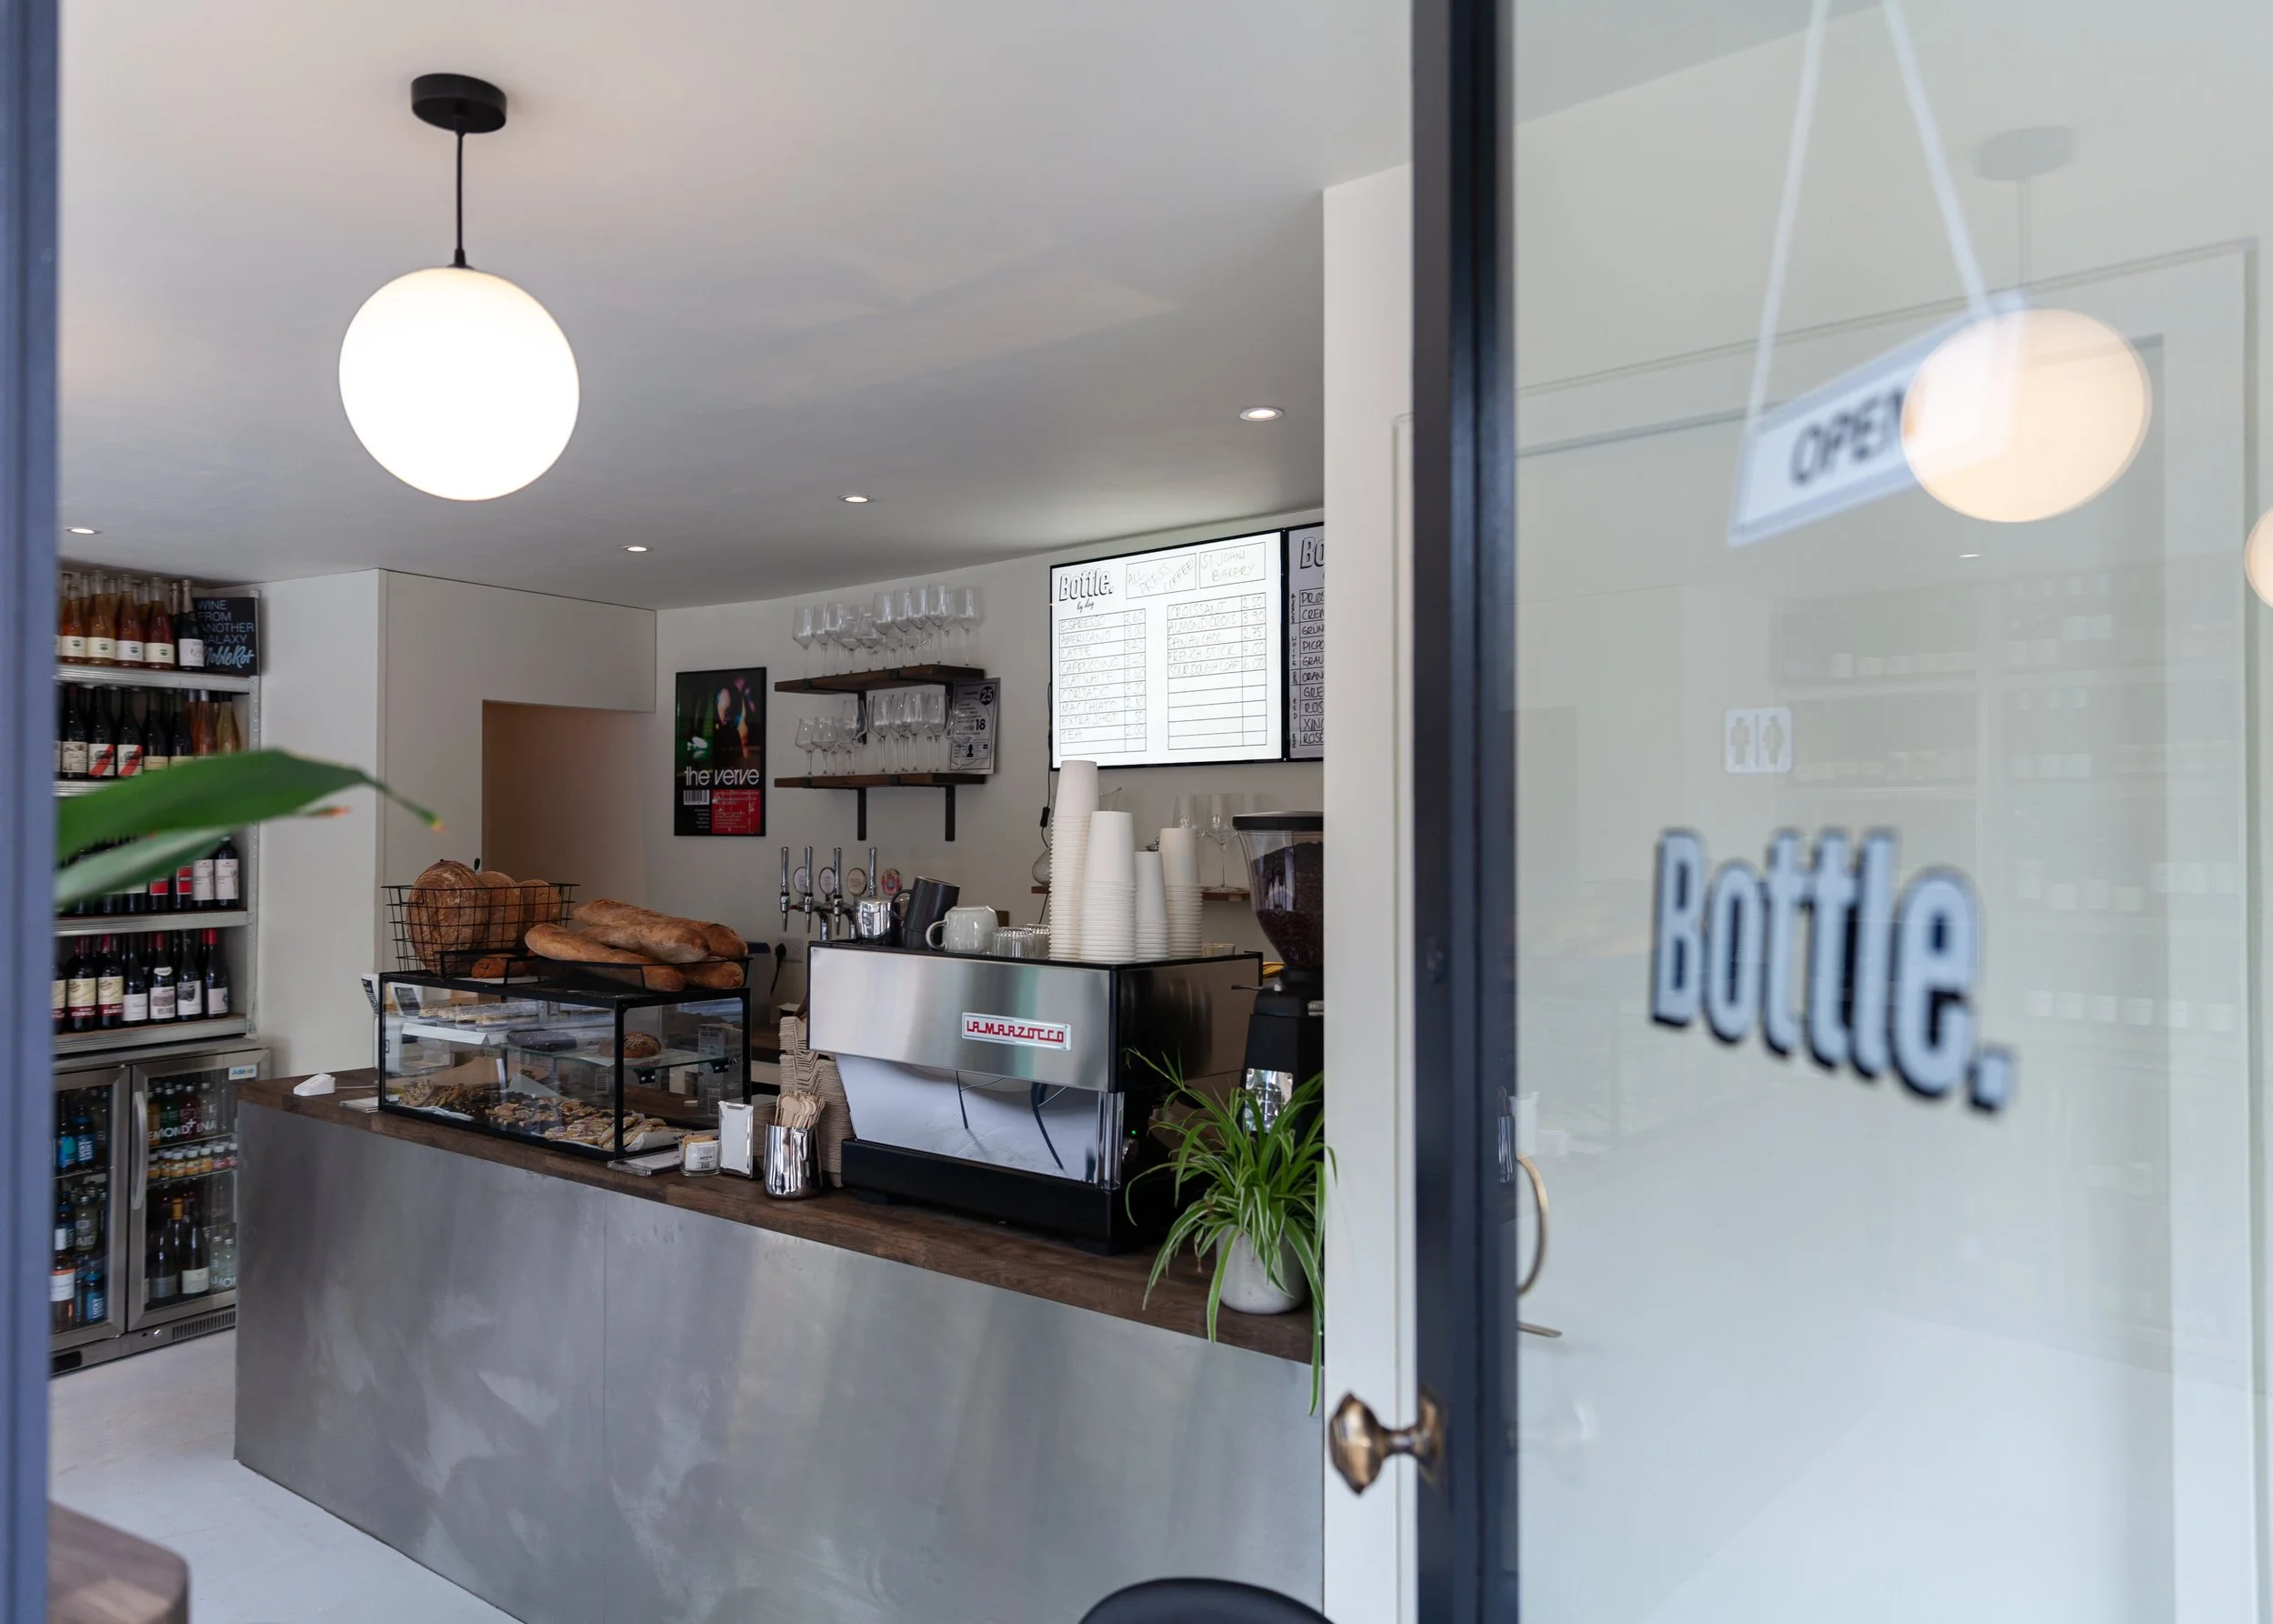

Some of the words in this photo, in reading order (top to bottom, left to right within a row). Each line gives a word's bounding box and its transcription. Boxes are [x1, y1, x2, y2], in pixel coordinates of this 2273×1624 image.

[1058, 568, 1115, 602] Bottle.
[197, 599, 226, 610] WINE
[197, 611, 232, 622] FROM
[1060, 646, 1092, 659] LATTE
[975, 718, 986, 731] 18
[1061, 730, 1082, 741] TEA
[684, 766, 710, 786] the
[715, 768, 760, 786] verve
[1648, 827, 2019, 1117] Bottle.
